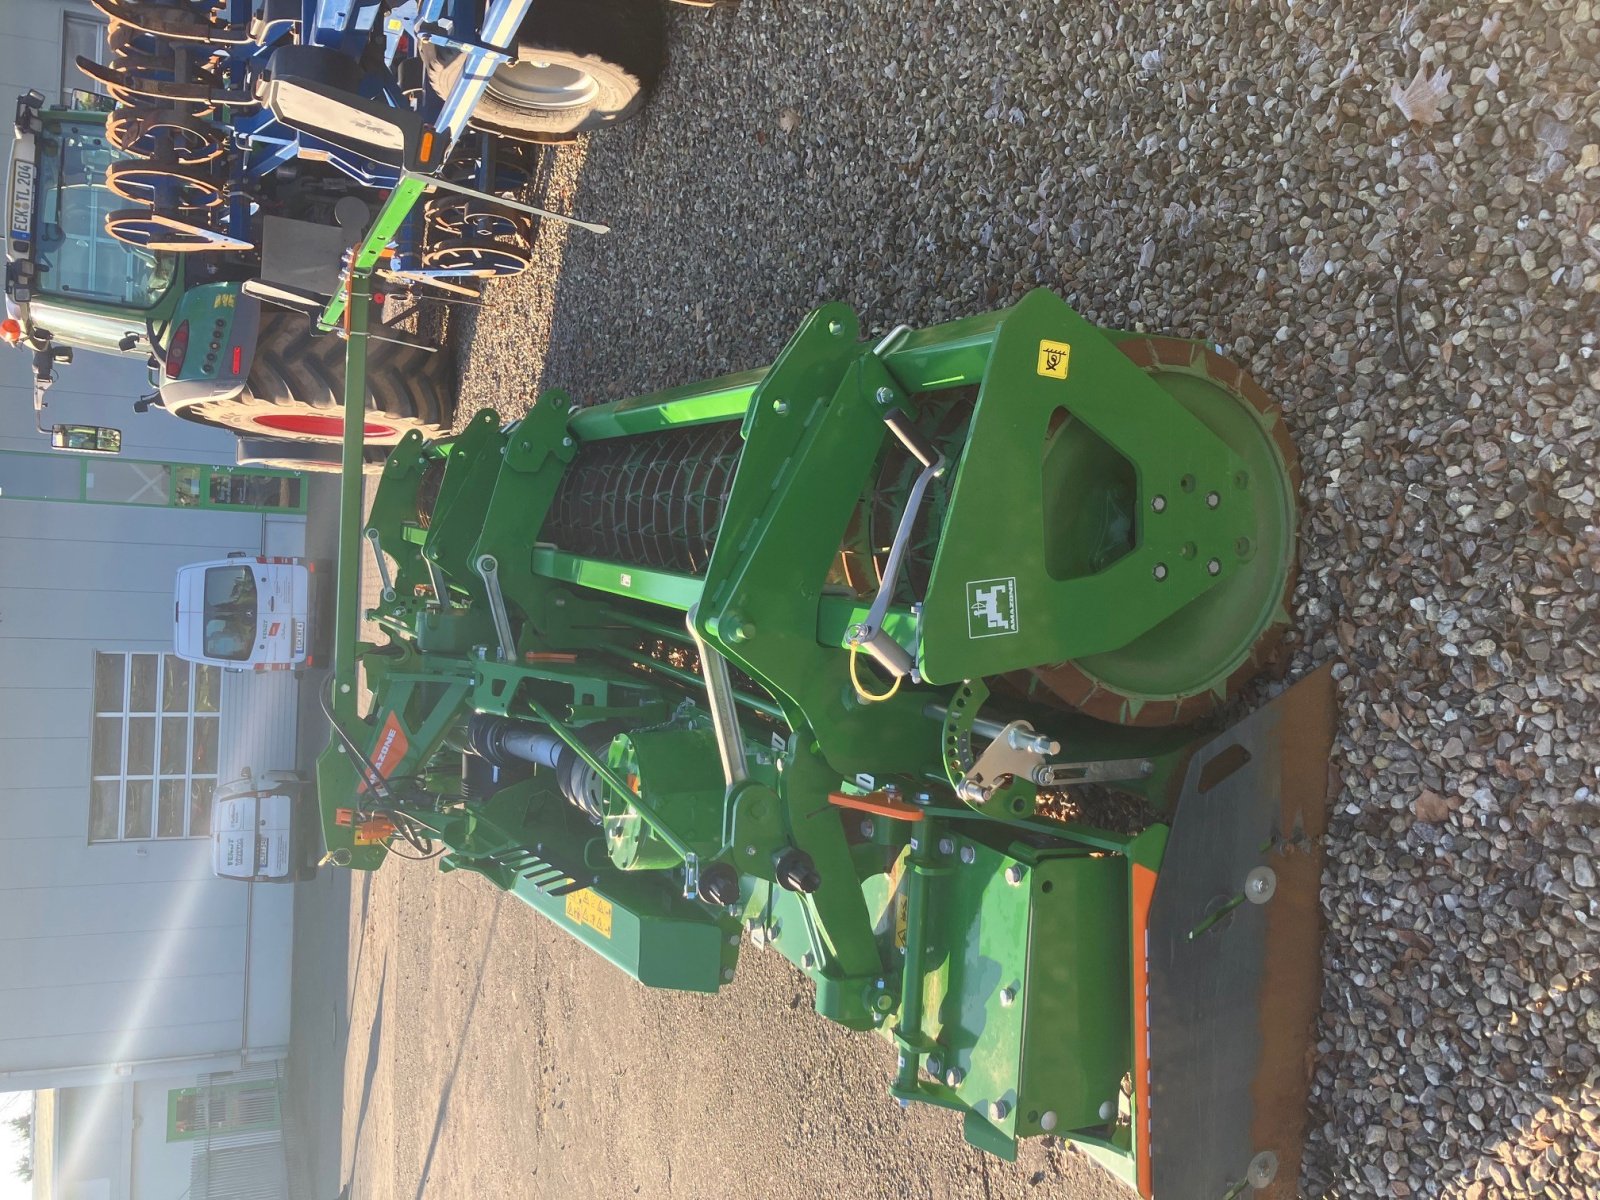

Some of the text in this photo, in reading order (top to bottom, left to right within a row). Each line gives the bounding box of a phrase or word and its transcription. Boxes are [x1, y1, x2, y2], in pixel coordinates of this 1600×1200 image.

[14, 165, 31, 231] ECK TL 204
